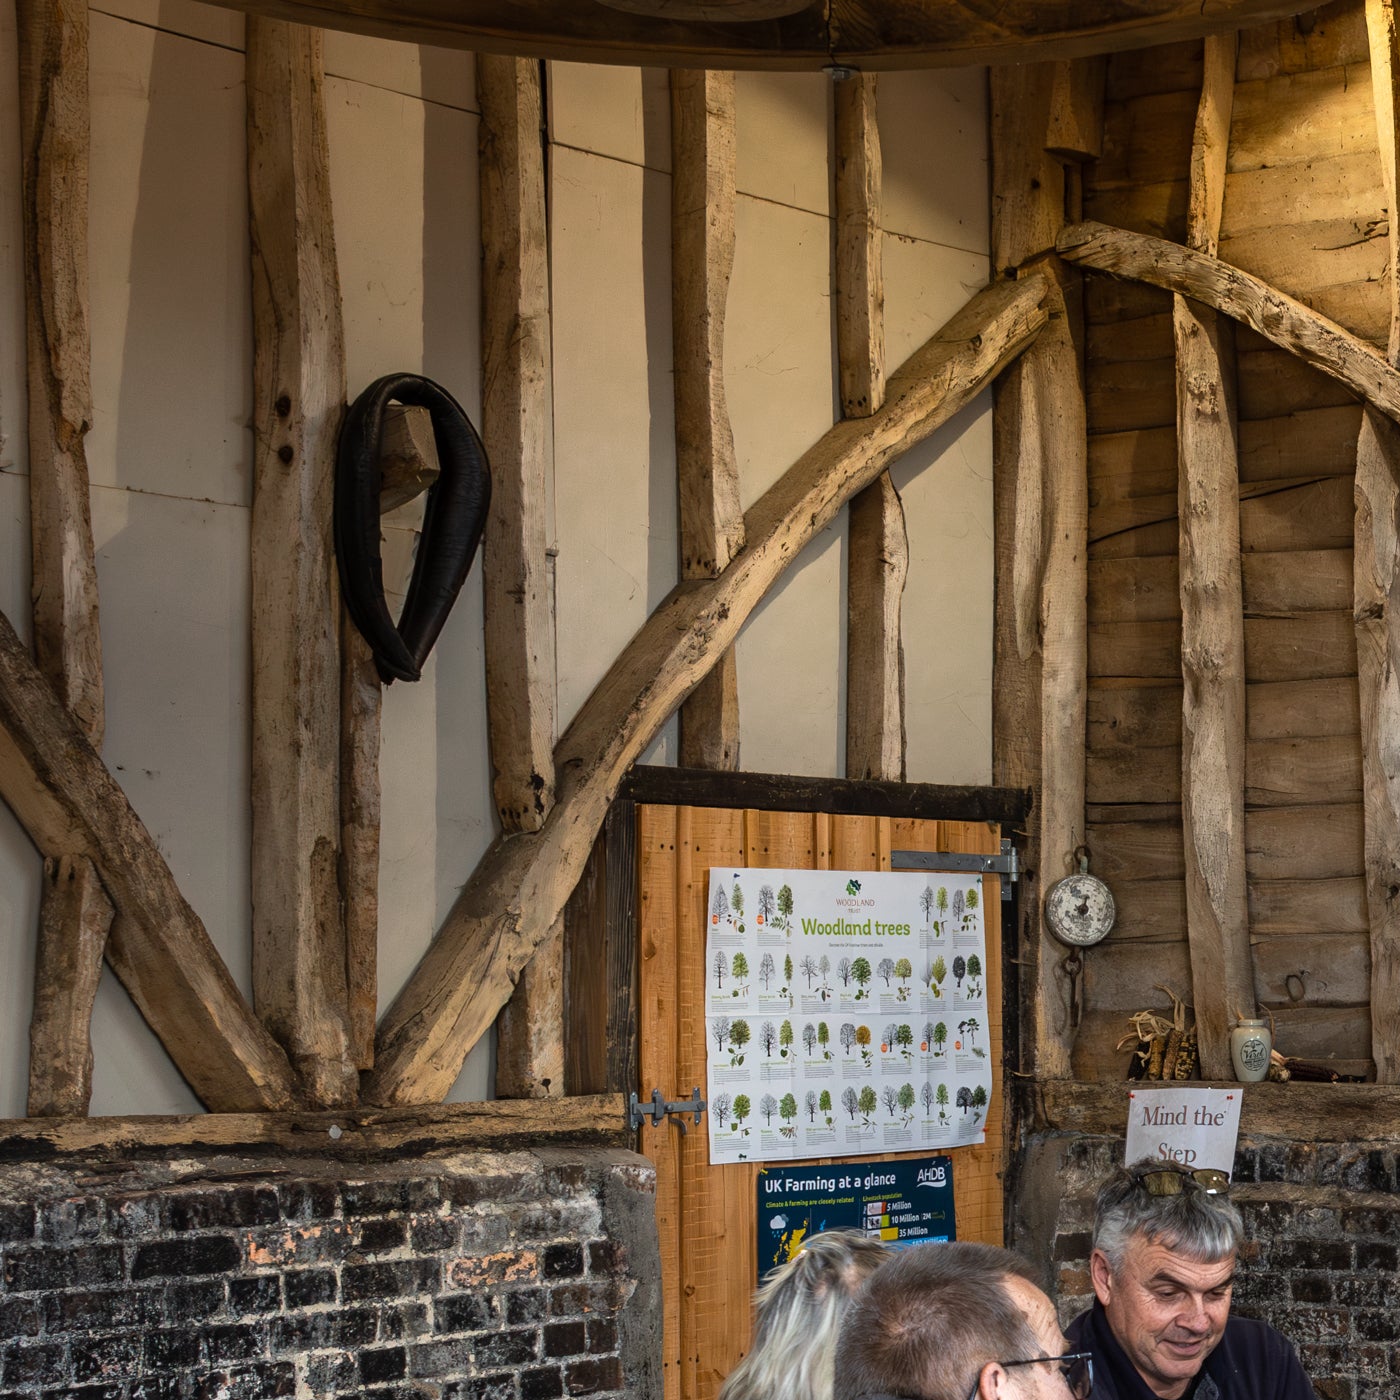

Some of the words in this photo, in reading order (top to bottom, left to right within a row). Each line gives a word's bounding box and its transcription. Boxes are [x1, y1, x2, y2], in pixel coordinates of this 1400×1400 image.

[836, 899, 875, 907] WOODLAND
[801, 918, 872, 936] Woodland
[875, 920, 911, 936] trees
[1141, 1105, 1188, 1126] Mind
[1194, 1106, 1224, 1126] the
[1158, 1142, 1197, 1165] Step
[917, 1166, 946, 1182] AHDB
[765, 1179, 783, 1193] UK
[785, 1176, 836, 1193] Farming
[838, 1176, 852, 1189] at
[854, 1178, 862, 1188] a
[864, 1172, 896, 1190] glance
[765, 1201, 784, 1209] Climate
[789, 1199, 809, 1207] farming
[818, 1197, 836, 1206] closely
[836, 1196, 855, 1204] related
[887, 1203, 891, 1212] 5
[891, 1201, 912, 1211] Million
[891, 1215, 898, 1224] 10
[899, 1213, 920, 1223] Million
[899, 1229, 906, 1237] 35
[907, 1227, 928, 1237] Million
